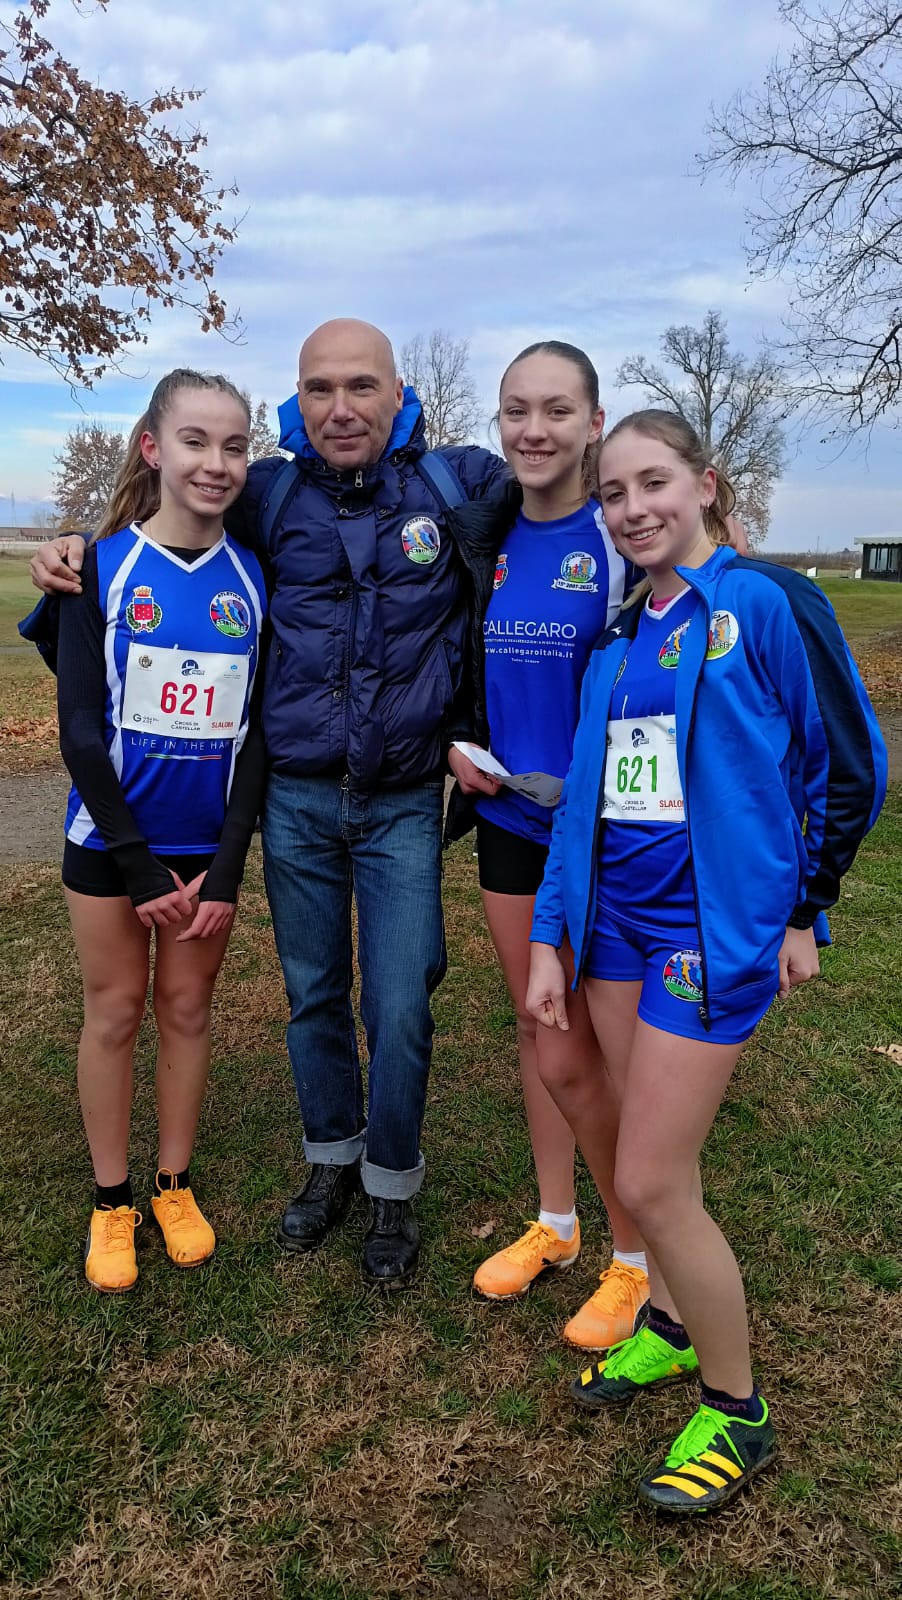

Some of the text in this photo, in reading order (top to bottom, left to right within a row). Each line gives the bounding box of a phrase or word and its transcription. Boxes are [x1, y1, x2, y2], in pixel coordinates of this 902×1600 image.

[483, 620, 577, 639] CALLEGARO
[161, 681, 215, 717] 621
[131, 737, 157, 748] LIFE
[164, 740, 177, 750] IN
[184, 741, 205, 751] THE
[617, 755, 657, 793] 621
[659, 799, 684, 808] SLALO
